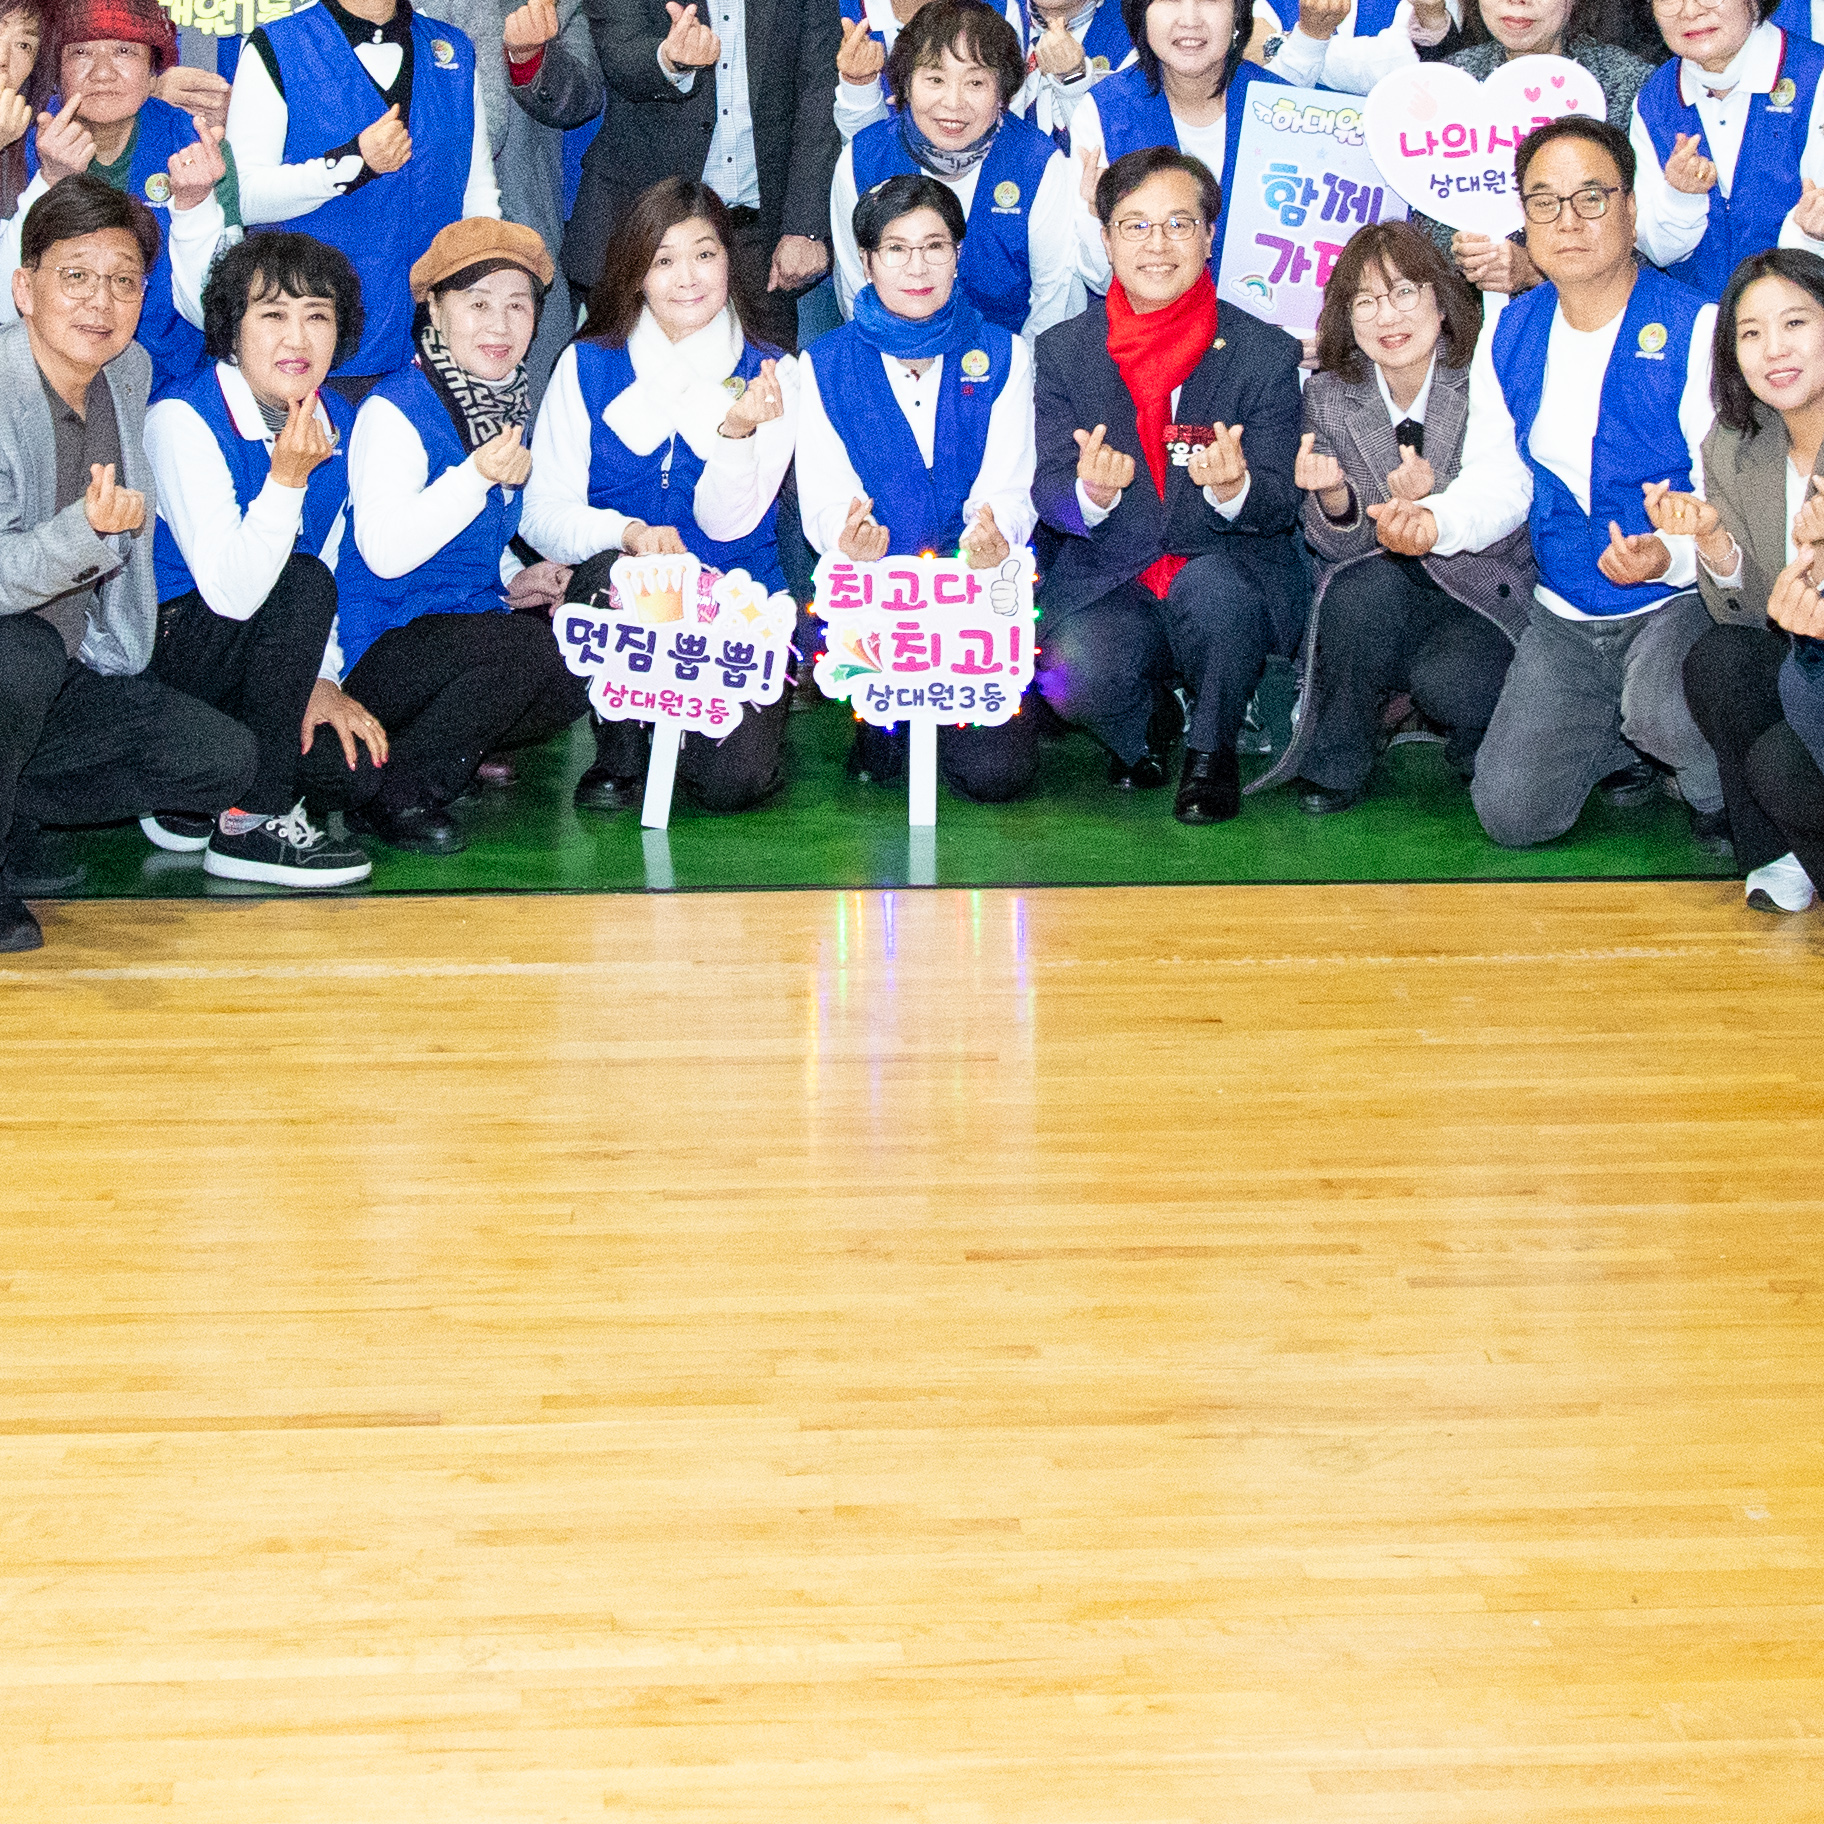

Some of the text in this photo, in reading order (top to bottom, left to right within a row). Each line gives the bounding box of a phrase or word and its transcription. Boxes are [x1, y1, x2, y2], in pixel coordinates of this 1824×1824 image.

[1271, 97, 1365, 146] 하대원
[1399, 116, 1556, 159] 나의 사
[1261, 162, 1384, 227] 함께
[1429, 169, 1520, 199] 상대원
[827, 563, 983, 612] 최고다
[565, 617, 775, 691] 멋짐 뿜뿜!
[891, 621, 1021, 676] 최고!
[602, 681, 730, 725] 상대원3동
[865, 682, 1006, 713] 상대원3동
